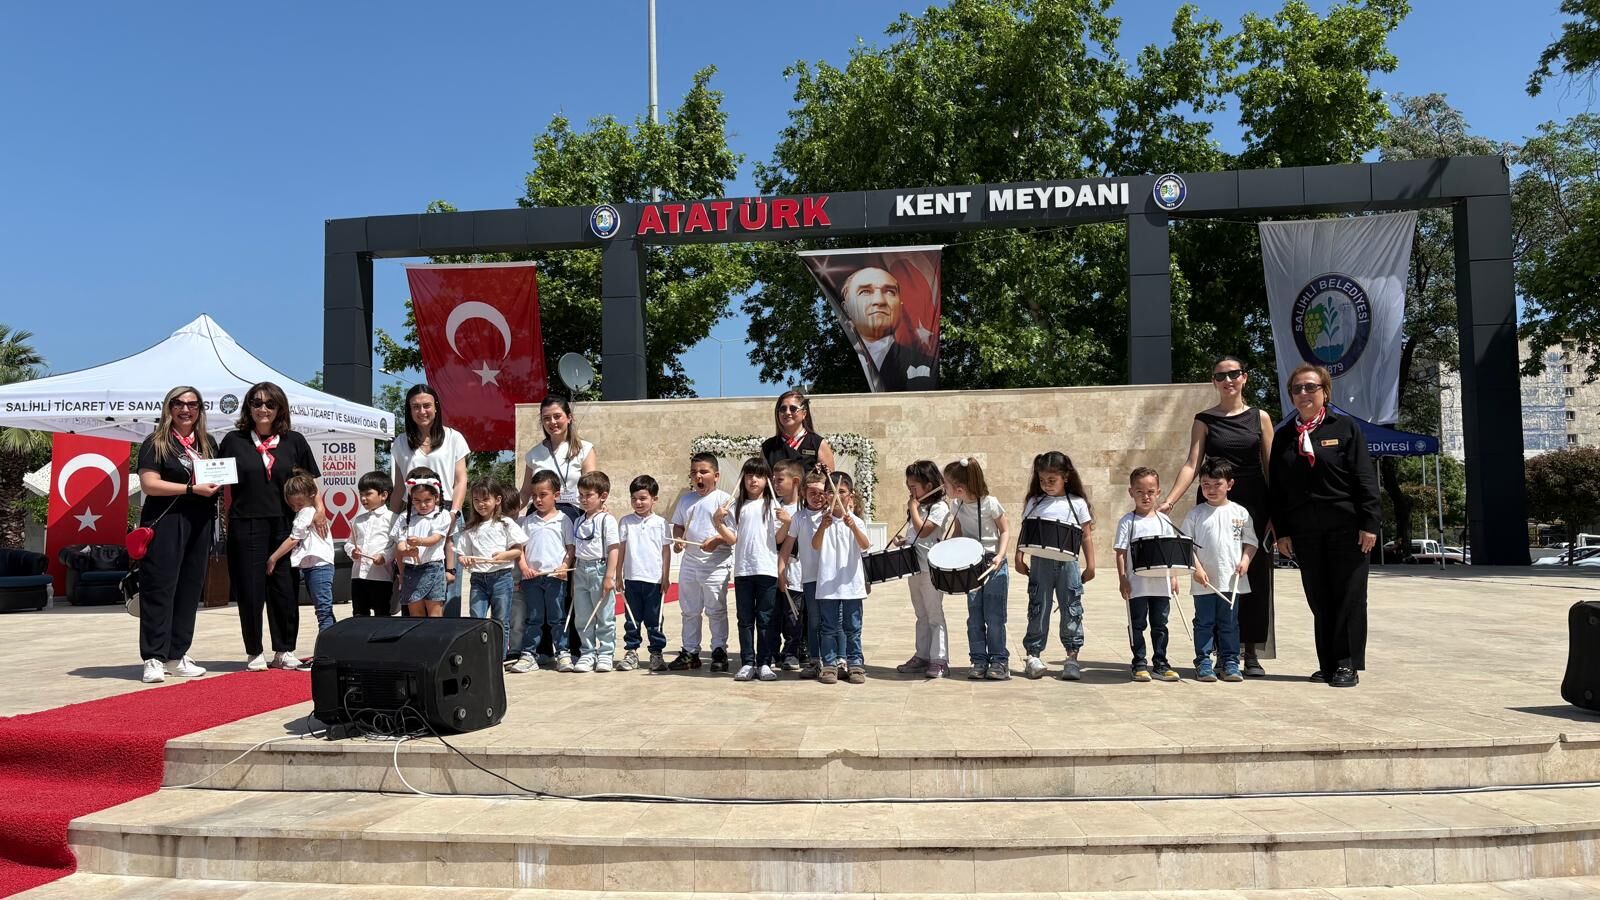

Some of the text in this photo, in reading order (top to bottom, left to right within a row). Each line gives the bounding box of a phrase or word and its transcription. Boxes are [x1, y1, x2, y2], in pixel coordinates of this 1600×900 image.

[896, 191, 972, 217] KENT
[989, 182, 1130, 212] MEYDANI
[637, 195, 831, 235] ATATÜRK
[1295, 278, 1369, 332] SALİHLİ BELEDİYESİ
[6, 399, 162, 413] SALİHLİ TİCARET VE SANA
[290, 404, 310, 416] ALİHLİ
[310, 408, 334, 420] TİCARET
[335, 412, 343, 422] VE
[343, 414, 363, 427] SANAYİ
[363, 418, 378, 429] ODASI
[322, 442, 356, 454] TOBB
[1367, 441, 1410, 452] EDİYESİ
[322, 461, 356, 471] KADIN
[323, 477, 356, 486] KURULU
